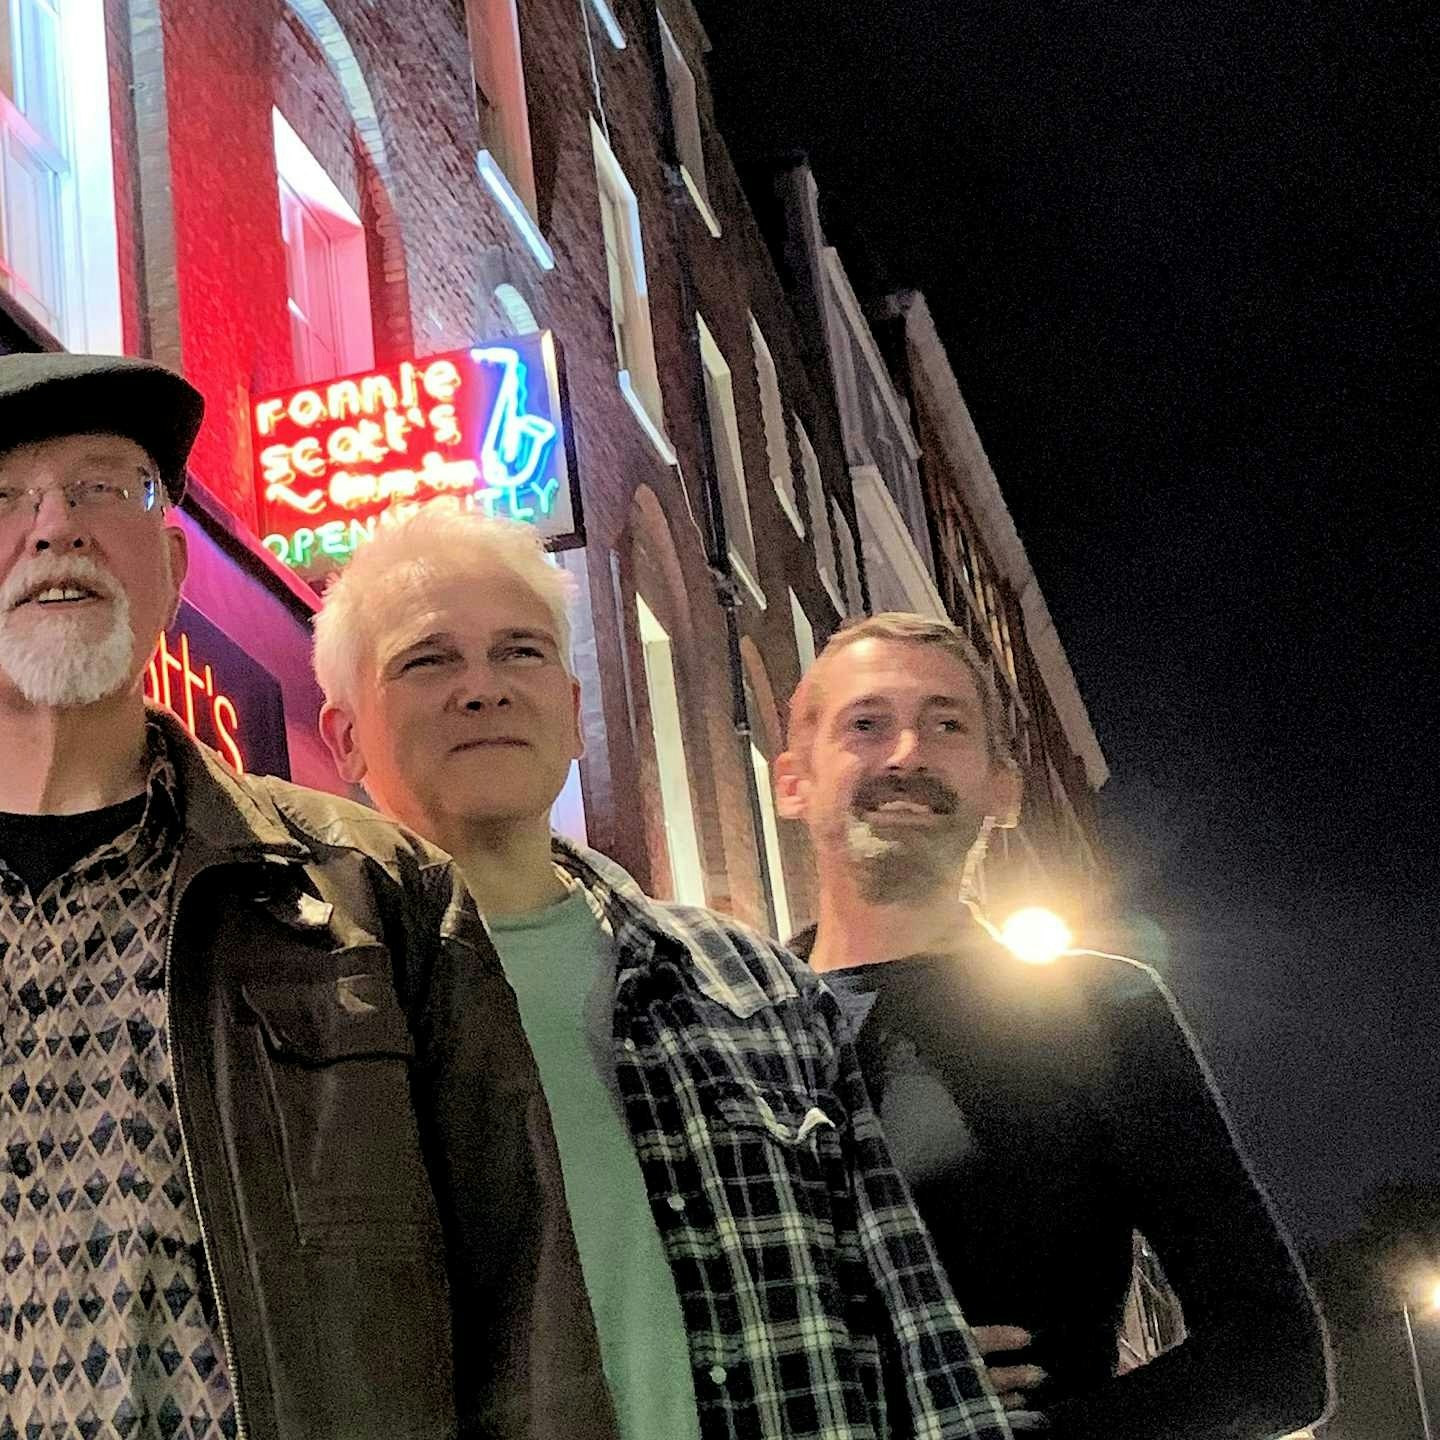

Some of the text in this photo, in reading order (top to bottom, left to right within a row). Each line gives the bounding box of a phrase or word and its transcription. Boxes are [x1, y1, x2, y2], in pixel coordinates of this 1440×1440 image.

[256, 360, 462, 435] ronnie
[260, 403, 462, 486] scott's
[261, 519, 377, 565] OPEN
